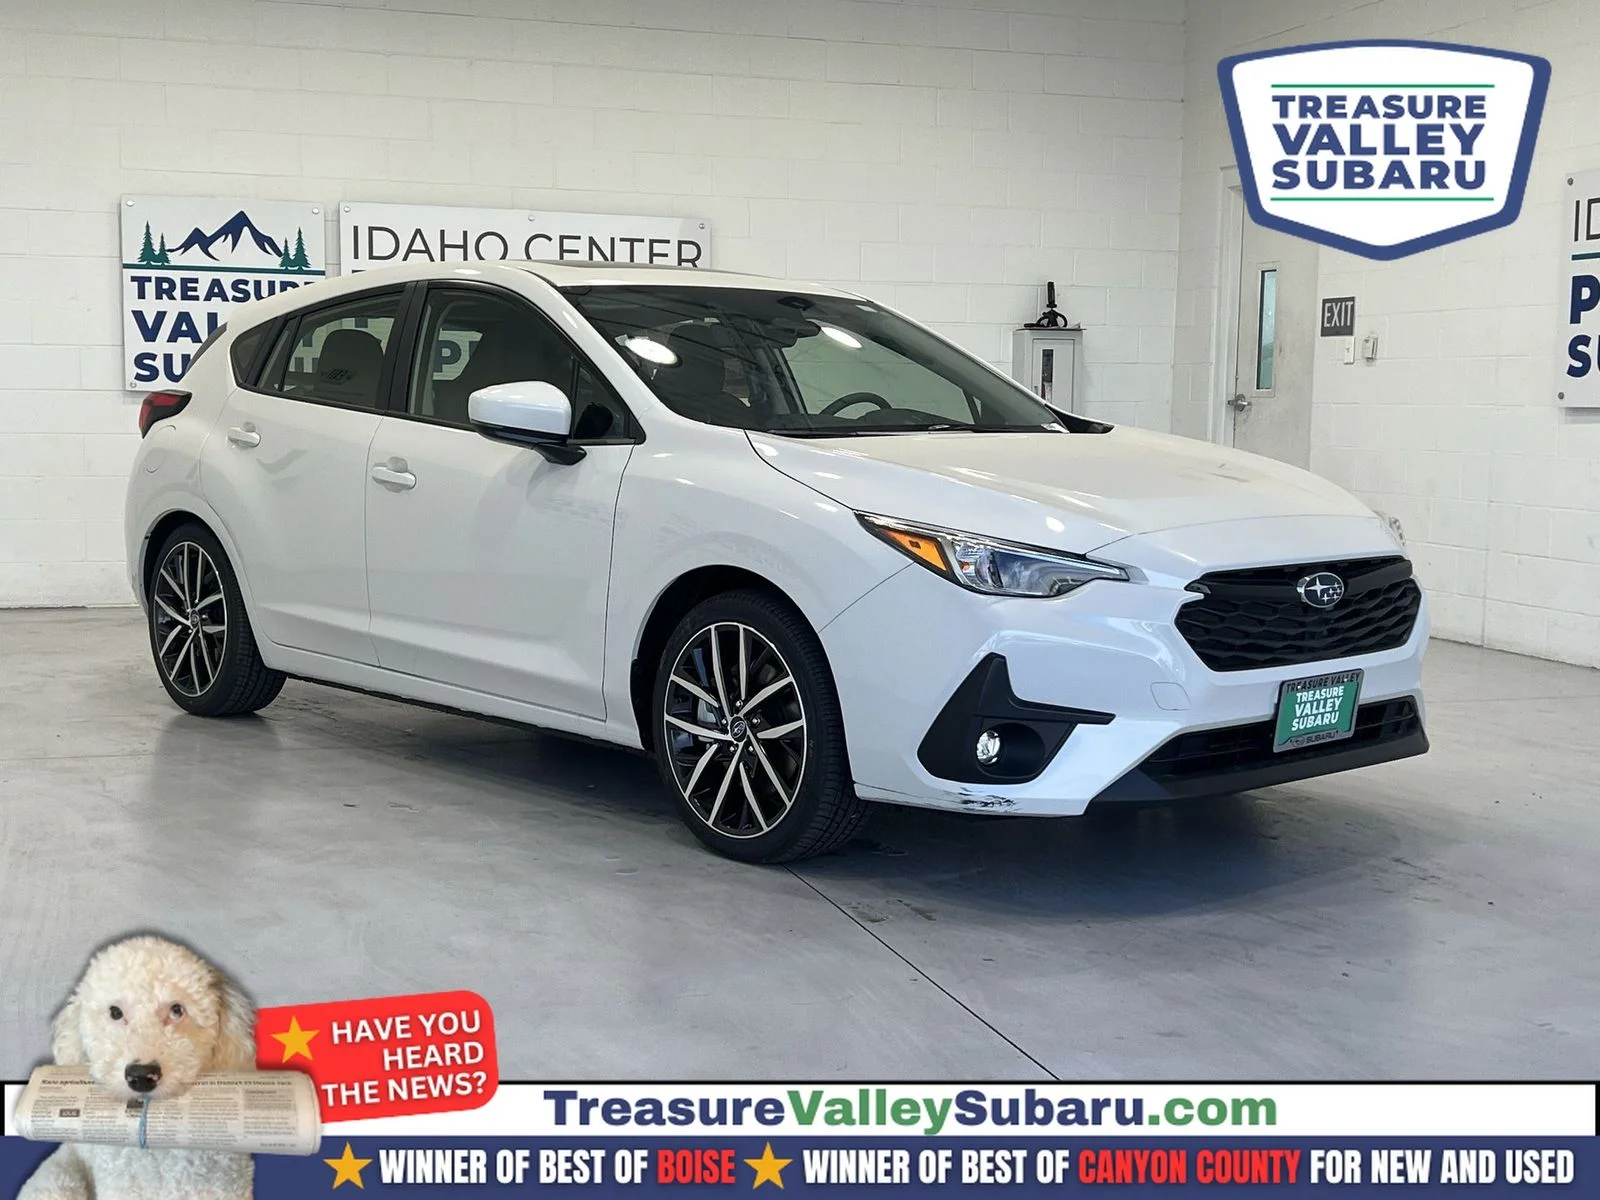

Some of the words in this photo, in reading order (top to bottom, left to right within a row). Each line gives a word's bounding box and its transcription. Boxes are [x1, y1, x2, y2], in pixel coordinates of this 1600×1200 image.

[353, 225, 508, 262] IDAHO
[130, 275, 315, 303] TREASU
[1323, 301, 1354, 327] EXIT
[1296, 685, 1344, 703] TREASURE
[1295, 697, 1342, 718] VALLEY
[1291, 712, 1339, 731] SUBARU
